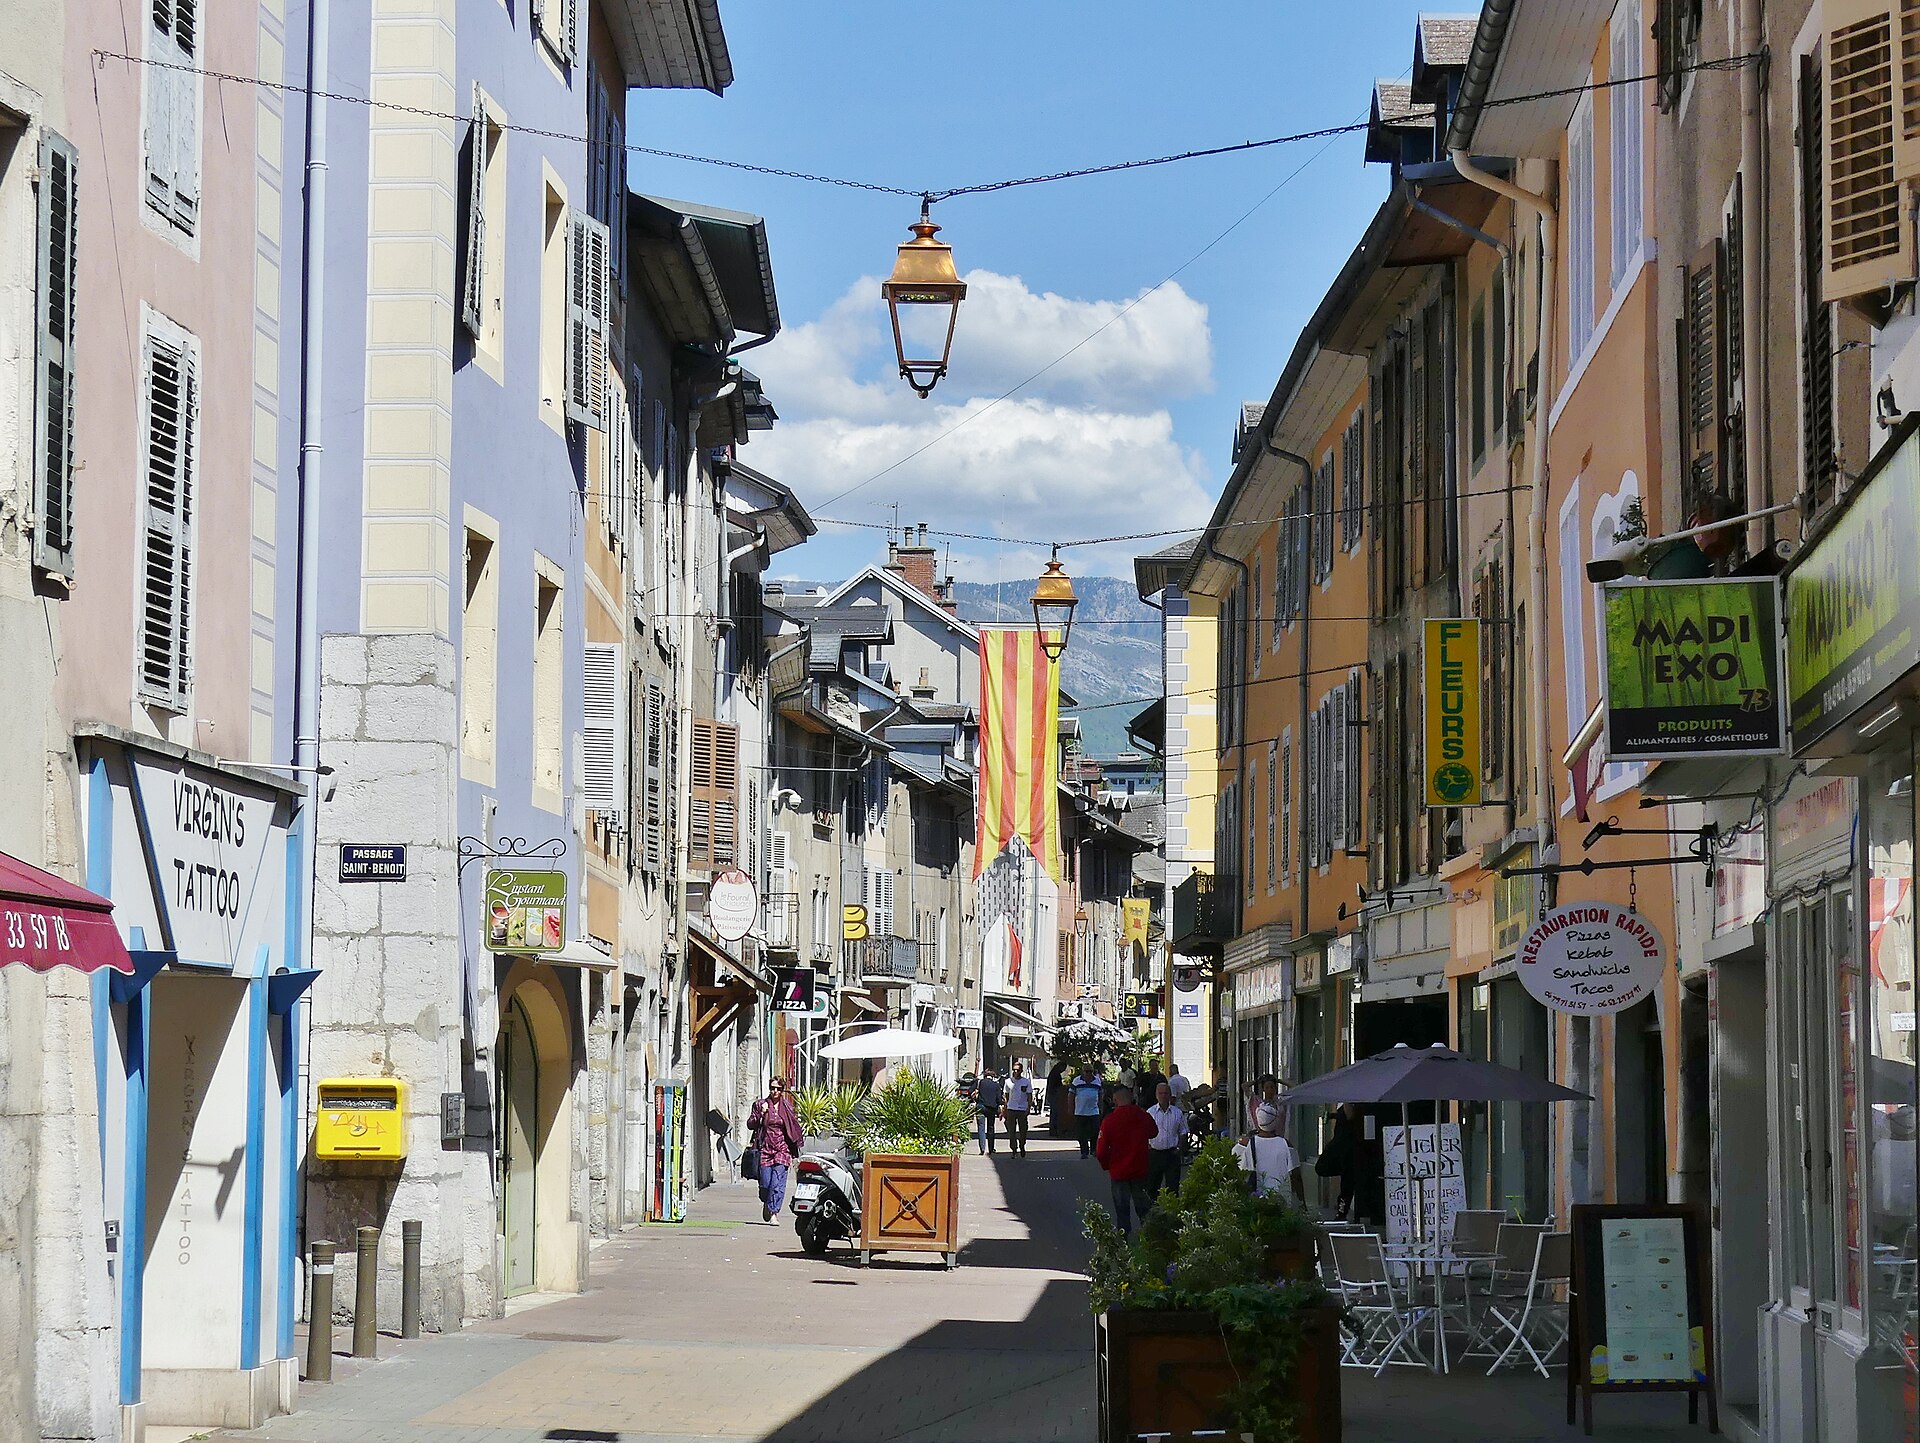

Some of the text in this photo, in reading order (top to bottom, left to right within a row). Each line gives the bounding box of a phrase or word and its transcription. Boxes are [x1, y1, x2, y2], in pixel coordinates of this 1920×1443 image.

[1632, 615, 1750, 647] MADI
[1655, 652, 1739, 683] EXO
[1440, 623, 1464, 760] FLEURS
[1738, 688, 1772, 712] 73
[1657, 719, 1733, 732] PRODUITS
[1626, 736, 1697, 746] ALIMANTAIRES
[1704, 733, 1769, 743] COSMETIQUES
[174, 779, 245, 848] VIRGIN'S
[353, 850, 394, 859] PASSAGE
[343, 862, 405, 875] SAINT-BENOIT
[174, 858, 240, 919] TATTOO
[490, 892, 567, 919] Gourmand
[5, 911, 70, 951] 33 59 78
[1522, 908, 1658, 964] RESTAURATION RAPIDE
[1566, 930, 1611, 943] Pizzas
[1570, 982, 1614, 995] Tacos
[776, 1000, 807, 1010] PIZZA
[179, 1171, 193, 1265] TATTOO
